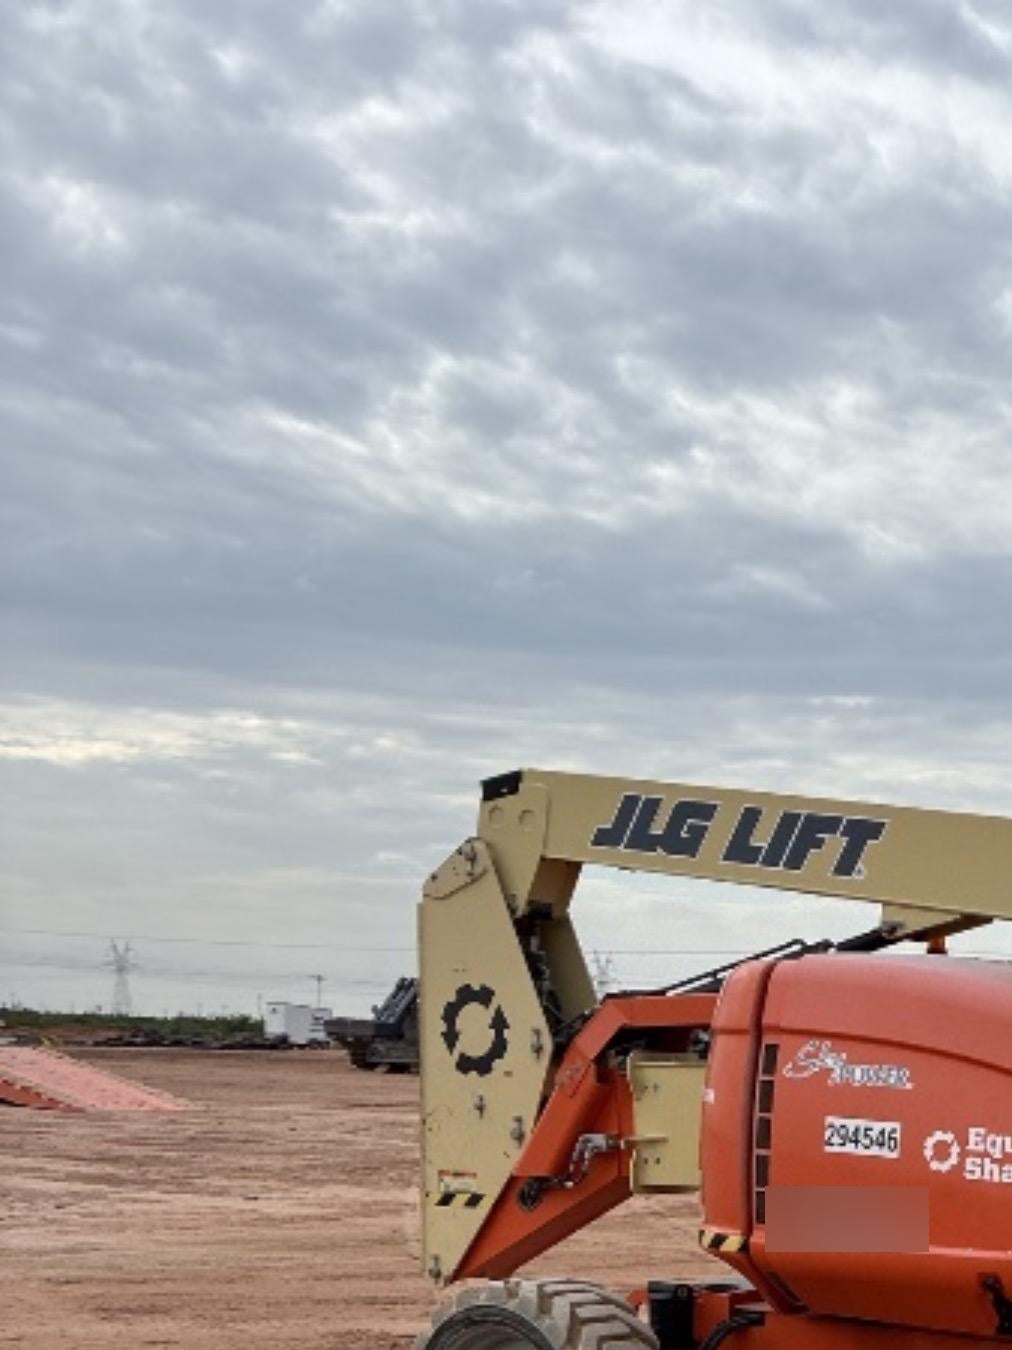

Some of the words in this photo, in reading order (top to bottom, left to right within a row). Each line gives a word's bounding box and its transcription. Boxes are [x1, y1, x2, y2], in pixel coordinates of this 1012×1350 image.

[589, 793, 721, 860] JLG
[721, 805, 888, 879] LIFT
[825, 1123, 898, 1153] 294546
